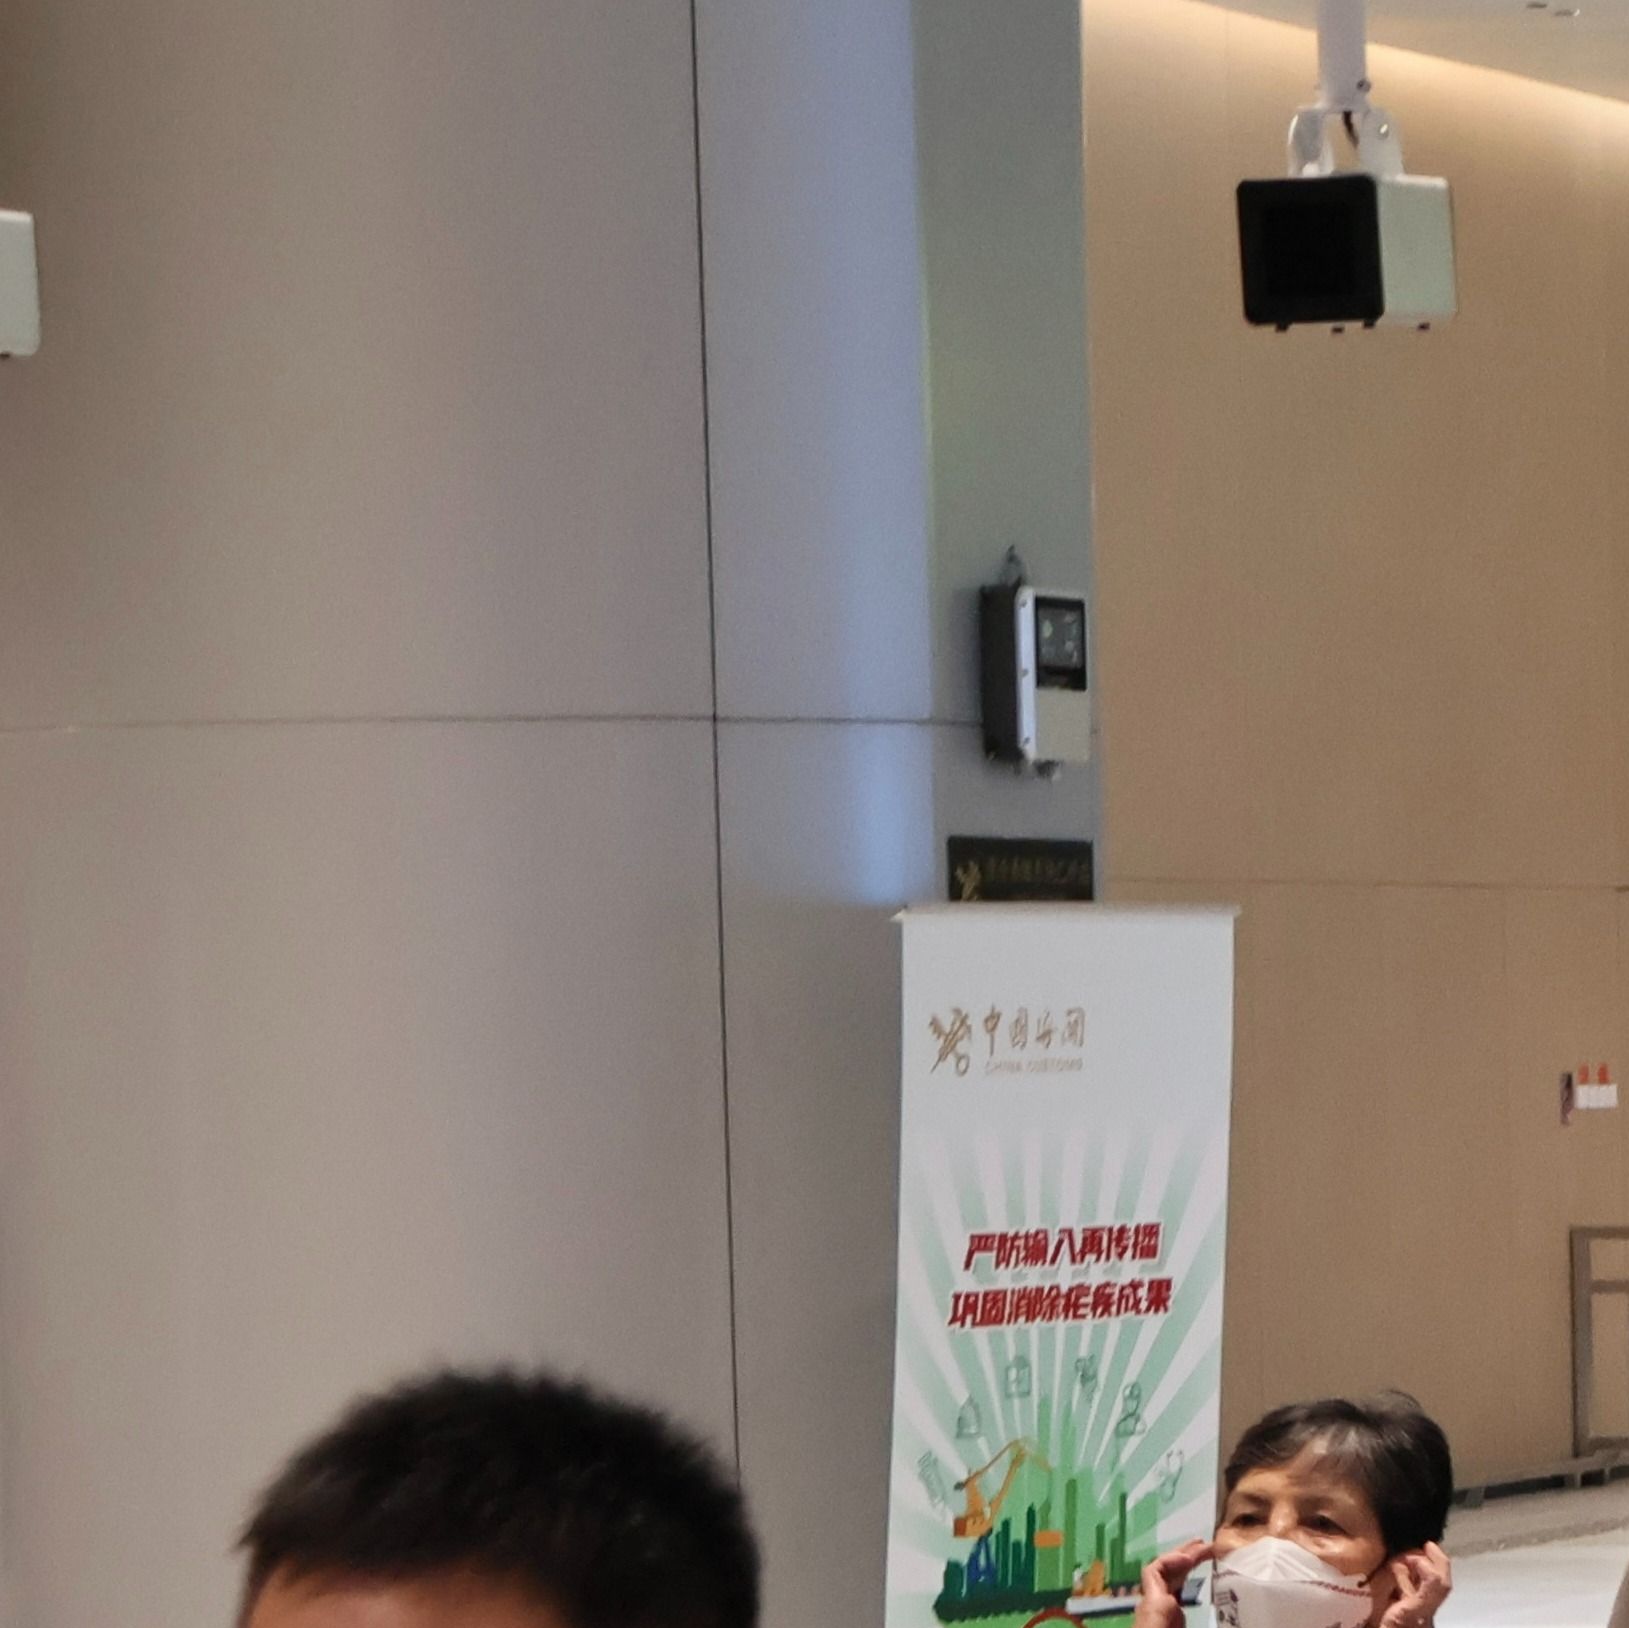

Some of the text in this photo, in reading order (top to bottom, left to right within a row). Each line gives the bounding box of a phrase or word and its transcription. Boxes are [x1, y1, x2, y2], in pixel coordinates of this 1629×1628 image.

[963, 1221, 1162, 1272] 严防输入再传播
[948, 1277, 1173, 1328] 巩固消除疟疾成果
